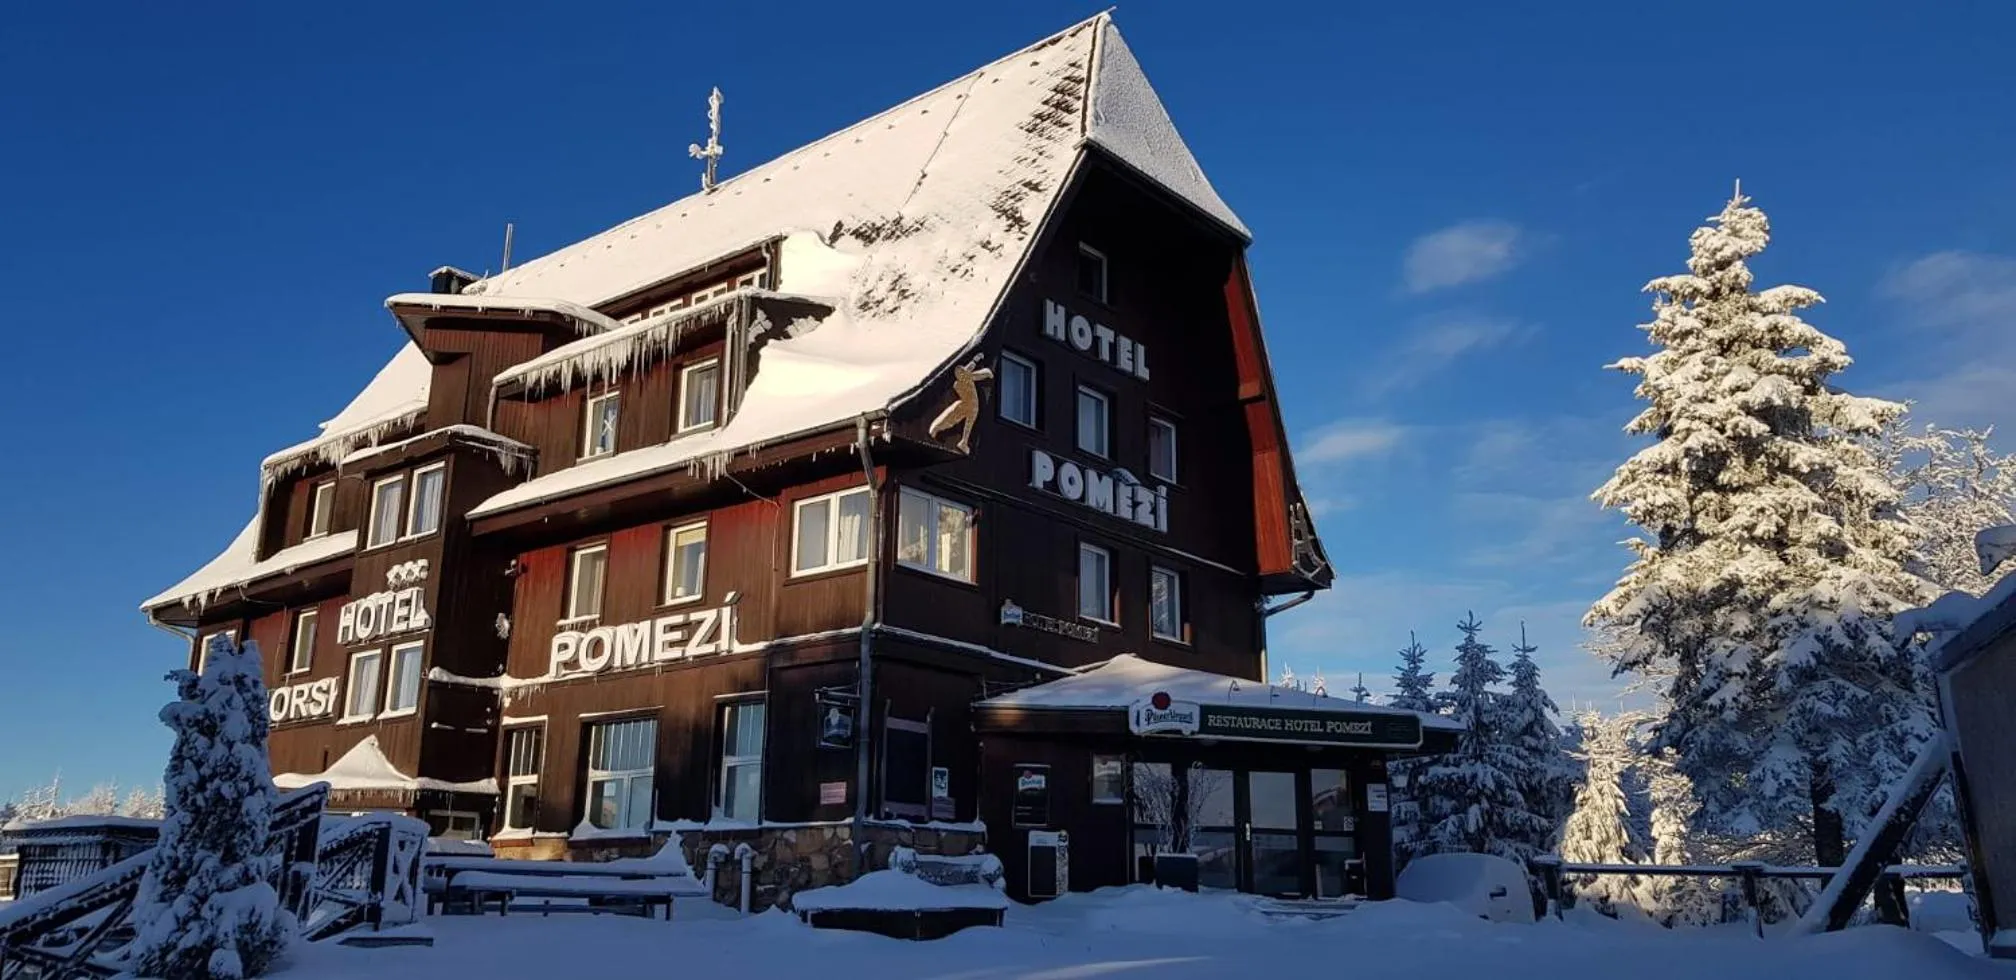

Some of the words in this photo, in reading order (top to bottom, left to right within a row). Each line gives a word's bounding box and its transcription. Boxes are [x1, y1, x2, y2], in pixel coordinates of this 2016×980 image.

[1043, 299, 1150, 381] HOTEL
[337, 587, 428, 643] HOTEL
[550, 591, 741, 677] POMEZÍ
[1208, 714, 1282, 731] RESTAURACE
[1284, 718, 1324, 733] HOTEL
[1326, 720, 1373, 735] POMEZÍ
